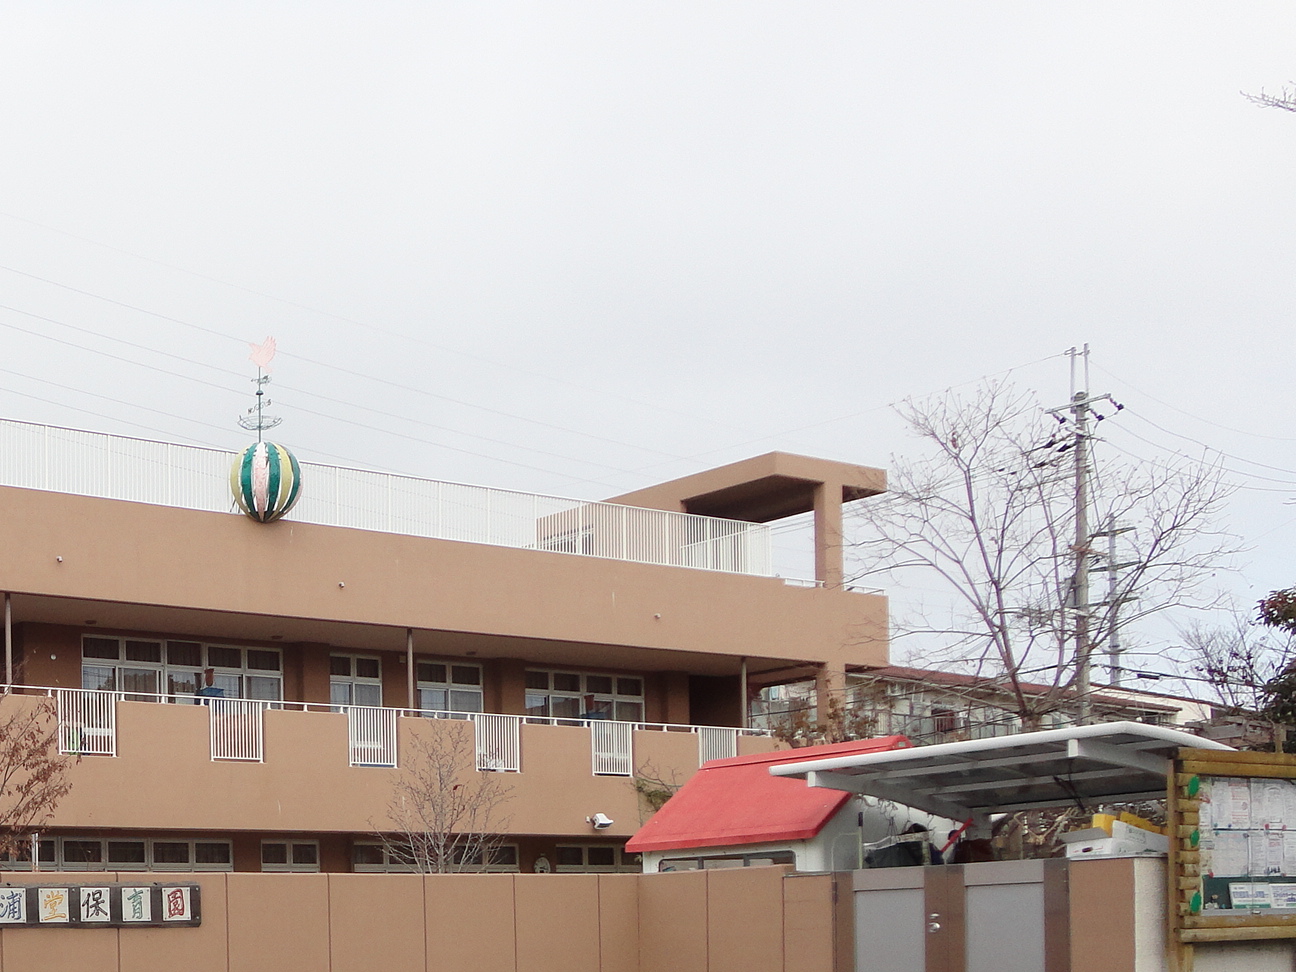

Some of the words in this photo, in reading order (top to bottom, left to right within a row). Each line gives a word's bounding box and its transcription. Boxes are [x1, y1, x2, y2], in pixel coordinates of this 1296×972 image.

[0, 888, 184, 921] 浦堂保育園
